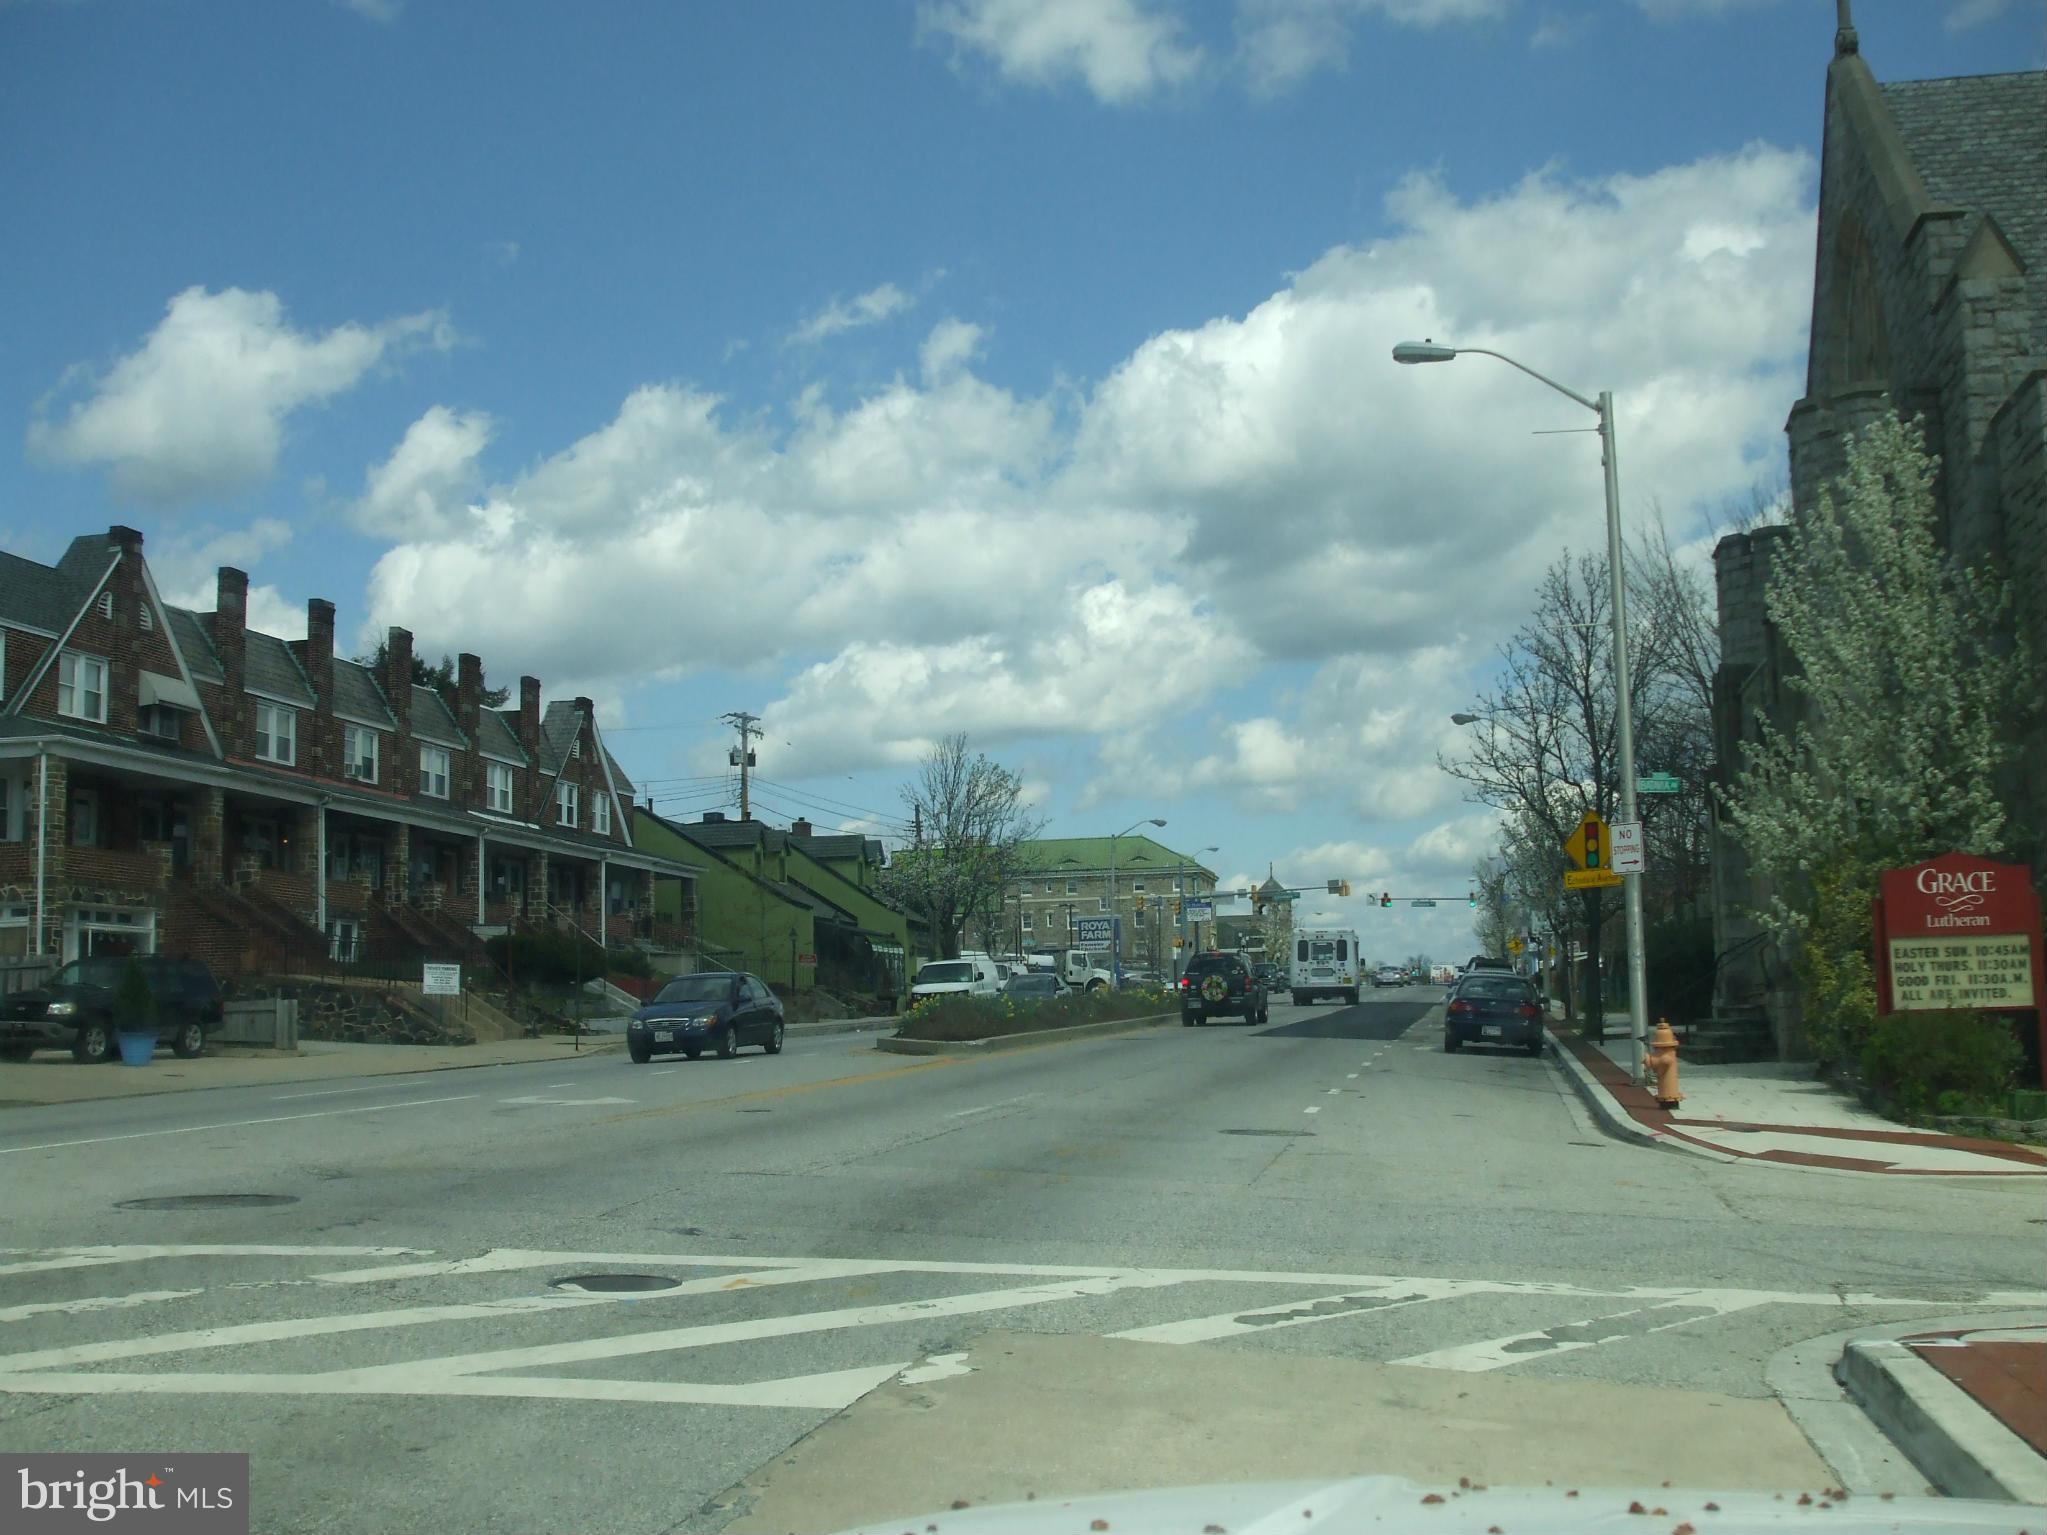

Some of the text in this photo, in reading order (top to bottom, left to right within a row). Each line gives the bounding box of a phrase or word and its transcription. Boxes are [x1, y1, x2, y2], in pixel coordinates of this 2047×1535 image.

[1619, 829, 1632, 839] NO
[1917, 868, 1996, 894] GRACE
[1080, 920, 1110, 931] ROYA
[1926, 914, 1991, 928] Lutheran
[1081, 930, 1111, 940] FARM
[1894, 947, 1939, 959] EASTER
[1976, 944, 2030, 956] 10:45AM
[1894, 959, 2027, 973] HOLY THURS. 11:30AM
[1896, 975, 1930, 987] GOOD
[1935, 974, 1961, 986] FRI.
[1901, 990, 1923, 1001] ALL
